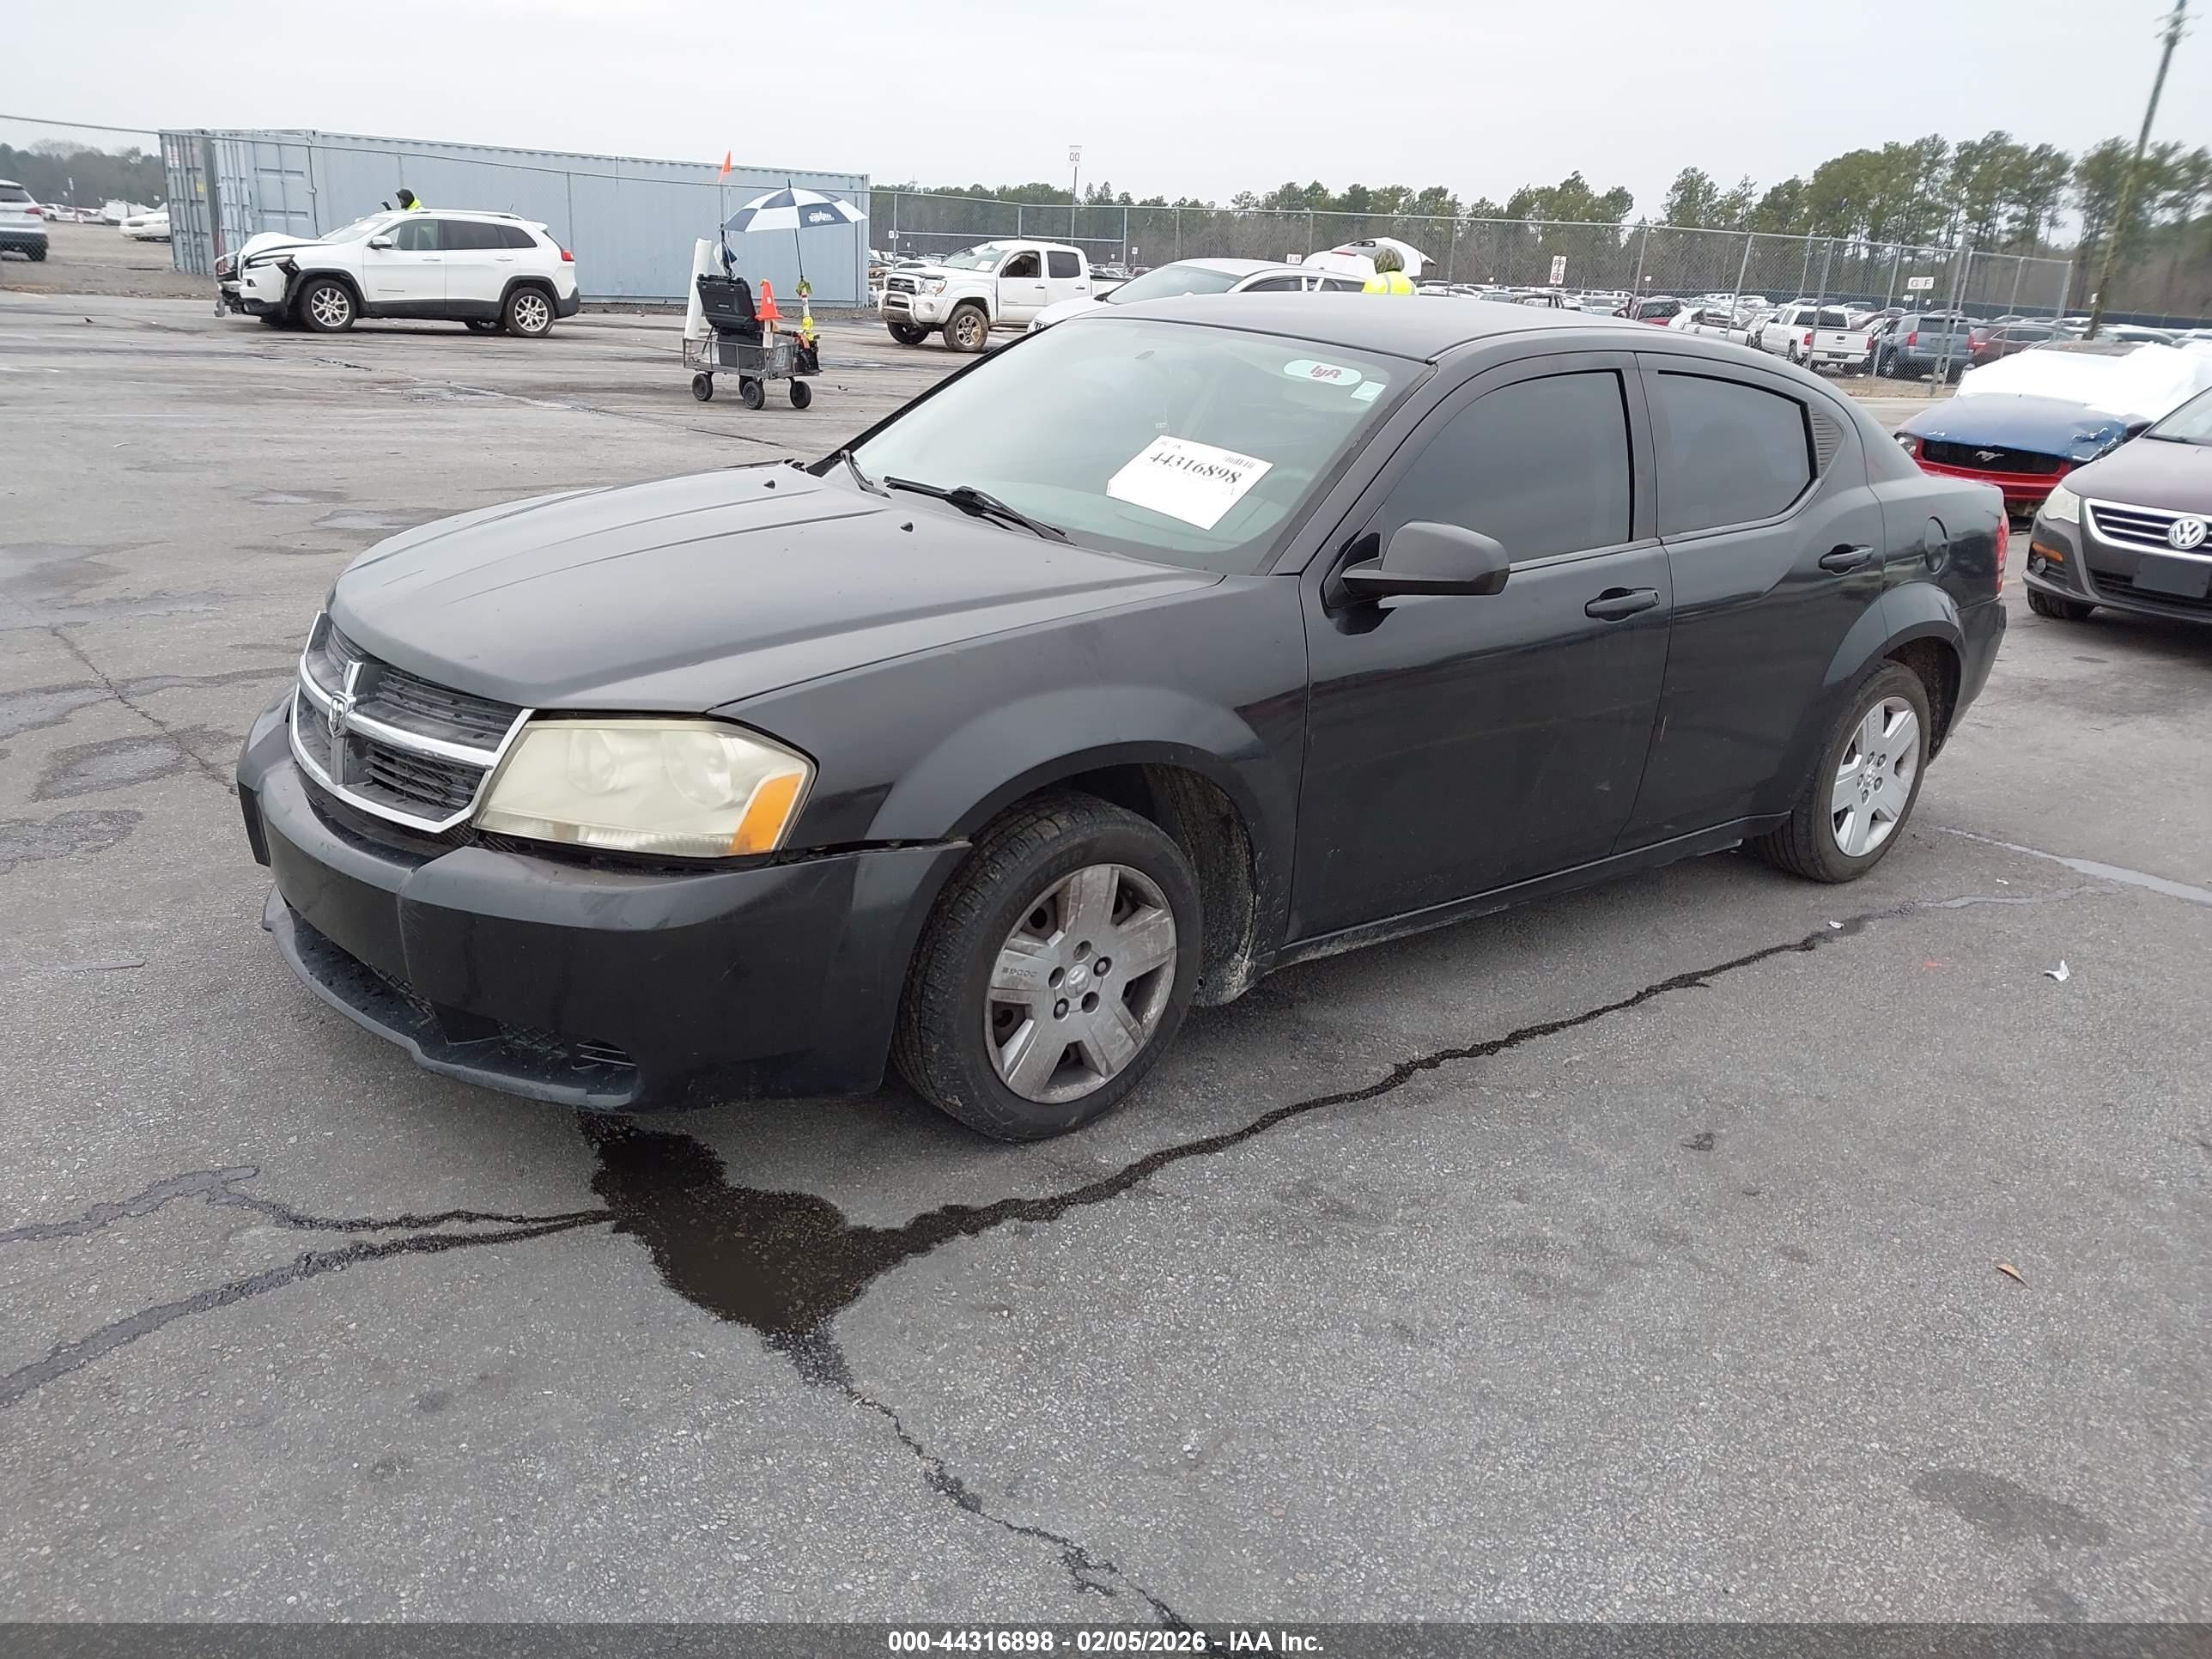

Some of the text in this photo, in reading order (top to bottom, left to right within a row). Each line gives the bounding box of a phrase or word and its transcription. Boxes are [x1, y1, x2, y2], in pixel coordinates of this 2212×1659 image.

[1911, 279, 1931, 288] G F
[1149, 452, 1243, 485] 44316898
